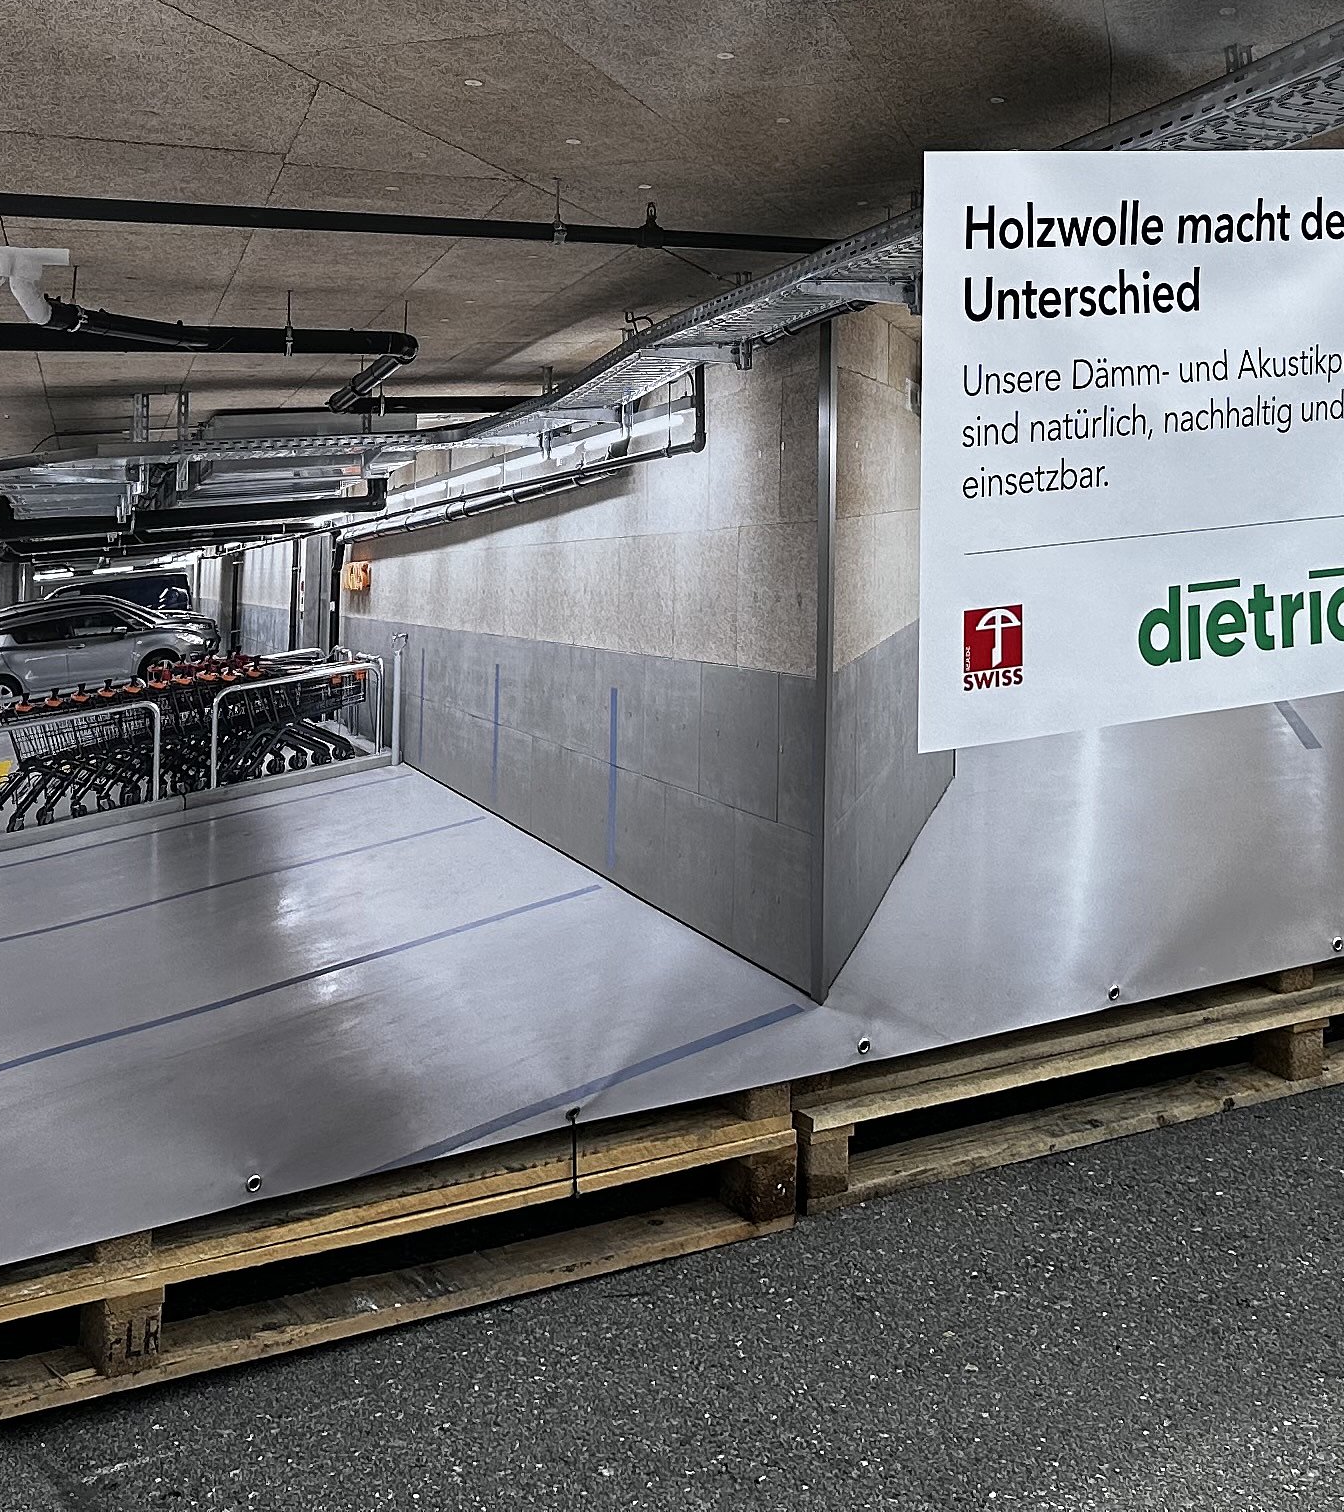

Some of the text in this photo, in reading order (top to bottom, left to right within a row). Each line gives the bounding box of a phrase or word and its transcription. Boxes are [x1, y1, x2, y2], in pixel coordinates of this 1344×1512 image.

[965, 199, 1164, 250] Holzwolle
[1177, 197, 1291, 245] macht
[964, 266, 1201, 323] Unterschied
[963, 363, 1062, 397] Unsere
[1072, 357, 1170, 390] Dämm-
[1179, 348, 1229, 384] und
[962, 410, 1019, 448] sind
[1030, 406, 1153, 443] natürlich,
[1164, 397, 1292, 434] nachhaltig
[1301, 388, 1344, 423] und
[962, 459, 1109, 500] einsetzbar.
[963, 668, 1024, 692] SWISS
